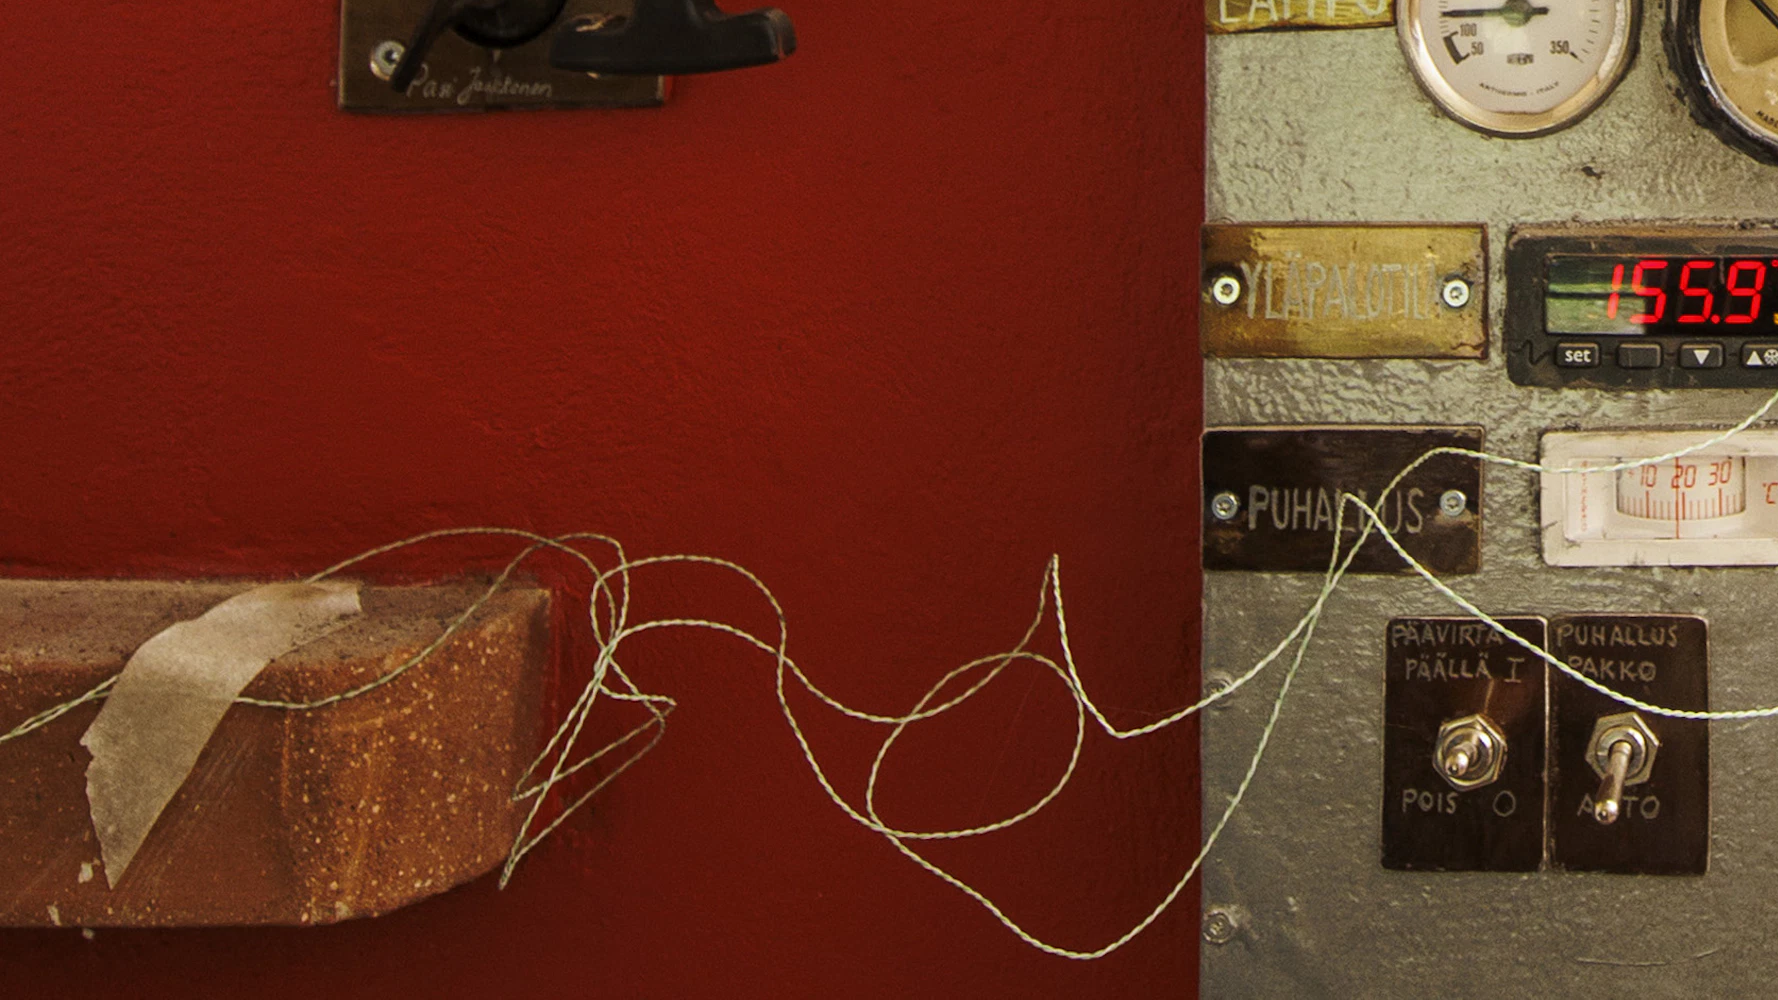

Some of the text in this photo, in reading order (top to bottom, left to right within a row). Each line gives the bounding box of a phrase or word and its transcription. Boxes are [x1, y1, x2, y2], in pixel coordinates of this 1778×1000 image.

[1460, 23, 1477, 37] 100
[1471, 41, 1485, 56] 50
[1549, 40, 1570, 55] 350
[1607, 260, 1767, 325] 155.9
[1564, 348, 1592, 363] set
[1671, 464, 1697, 489] 20
[1708, 460, 1733, 486] 30
[1762, 482, 1778, 504] °C
[1248, 484, 1425, 534] PUHALLUS
[1391, 620, 1504, 648] PÄÄVIRTA
[1556, 623, 1679, 648] PUHALLUS
[1405, 651, 1495, 682] PÄÄLLÄ
[1567, 654, 1657, 682] PAKKO
[1401, 788, 1458, 815] POIS
[1576, 793, 1661, 819] ATO
